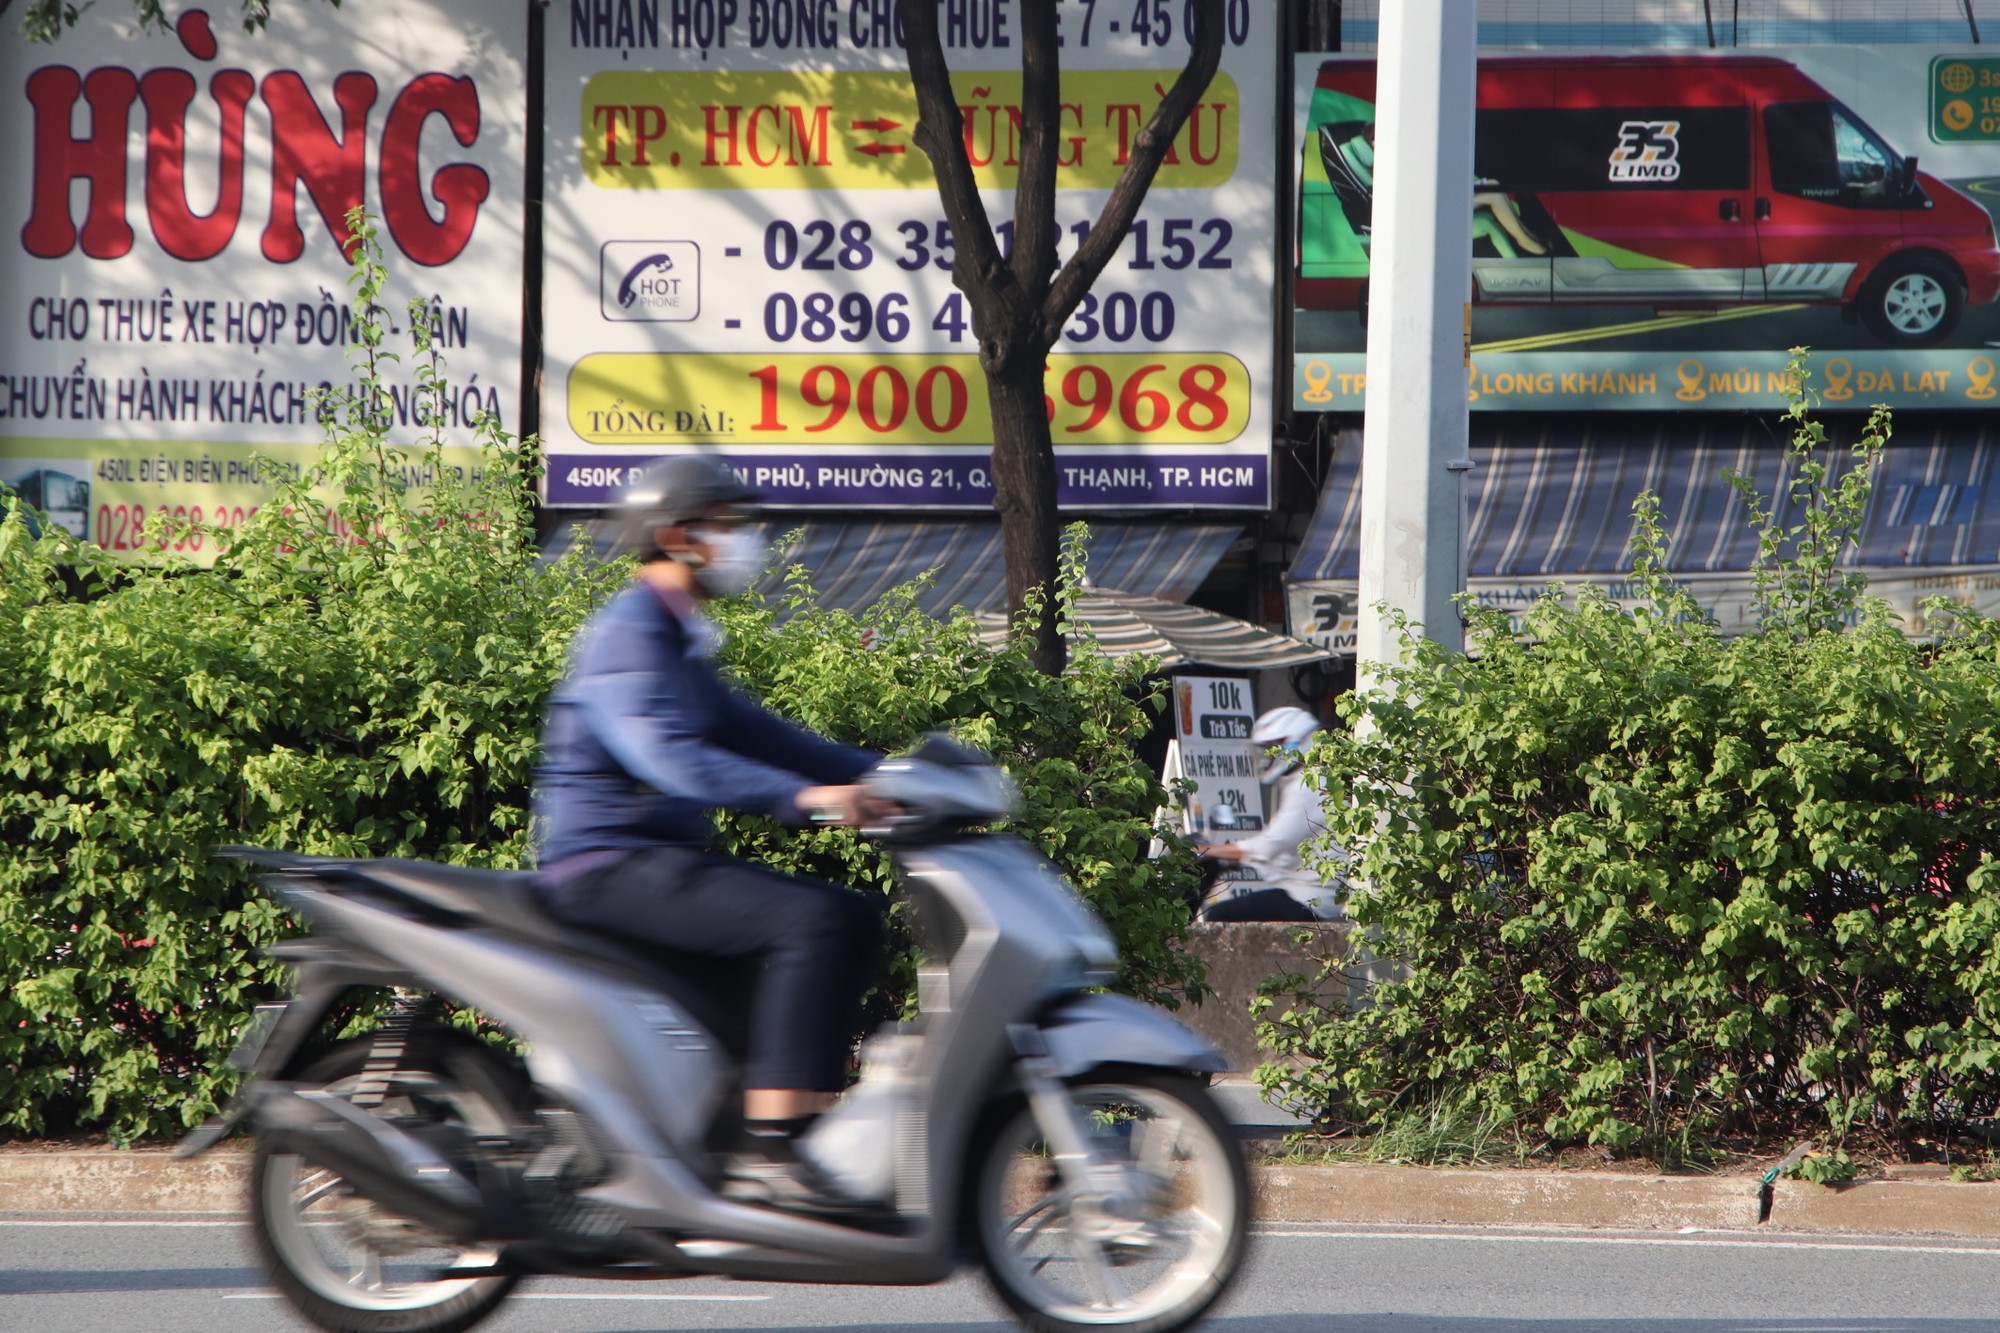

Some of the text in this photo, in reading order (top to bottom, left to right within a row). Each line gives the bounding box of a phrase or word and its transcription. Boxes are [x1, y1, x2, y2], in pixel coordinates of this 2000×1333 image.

[1131, 0, 1171, 47] 45
[21, 8, 490, 266] HÙNG
[593, 105, 681, 168] TP.
[700, 105, 833, 167] HCM
[1611, 165, 1678, 178] LIMO
[764, 219, 874, 271] 028
[1127, 218, 1233, 270] 152
[639, 297, 680, 308] PHONE
[640, 279, 682, 296] HOT
[29, 297, 89, 340] CHO
[98, 289, 174, 343] THUÊ
[184, 303, 215, 346] XE
[226, 300, 287, 354] HỢP
[764, 292, 911, 343] 0896
[1064, 290, 1175, 343] 300
[116, 367, 201, 421] HÀNH
[210, 369, 306, 425] KHÁCH
[587, 364, 1230, 433] TỔNG ĐÀI: 1900 968
[1482, 374, 1554, 394] LONG
[1561, 365, 1656, 394] KHÁNH
[1708, 368, 1761, 394] MŨI
[1856, 367, 1897, 393] ĐÀ
[1903, 370, 1952, 398] LẠT
[98, 459, 135, 482] 450L
[139, 453, 178, 488] ĐIỆN
[184, 455, 222, 484] BIÊN
[566, 467, 622, 487] 450K
[818, 462, 924, 488] PHƯỜNG
[931, 469, 962, 490] 21,
[968, 470, 992, 488] Q.
[1064, 469, 1153, 491] THẠNH,
[1160, 469, 1193, 487] TP.
[1201, 468, 1254, 487] HCM
[97, 503, 145, 551] 028
